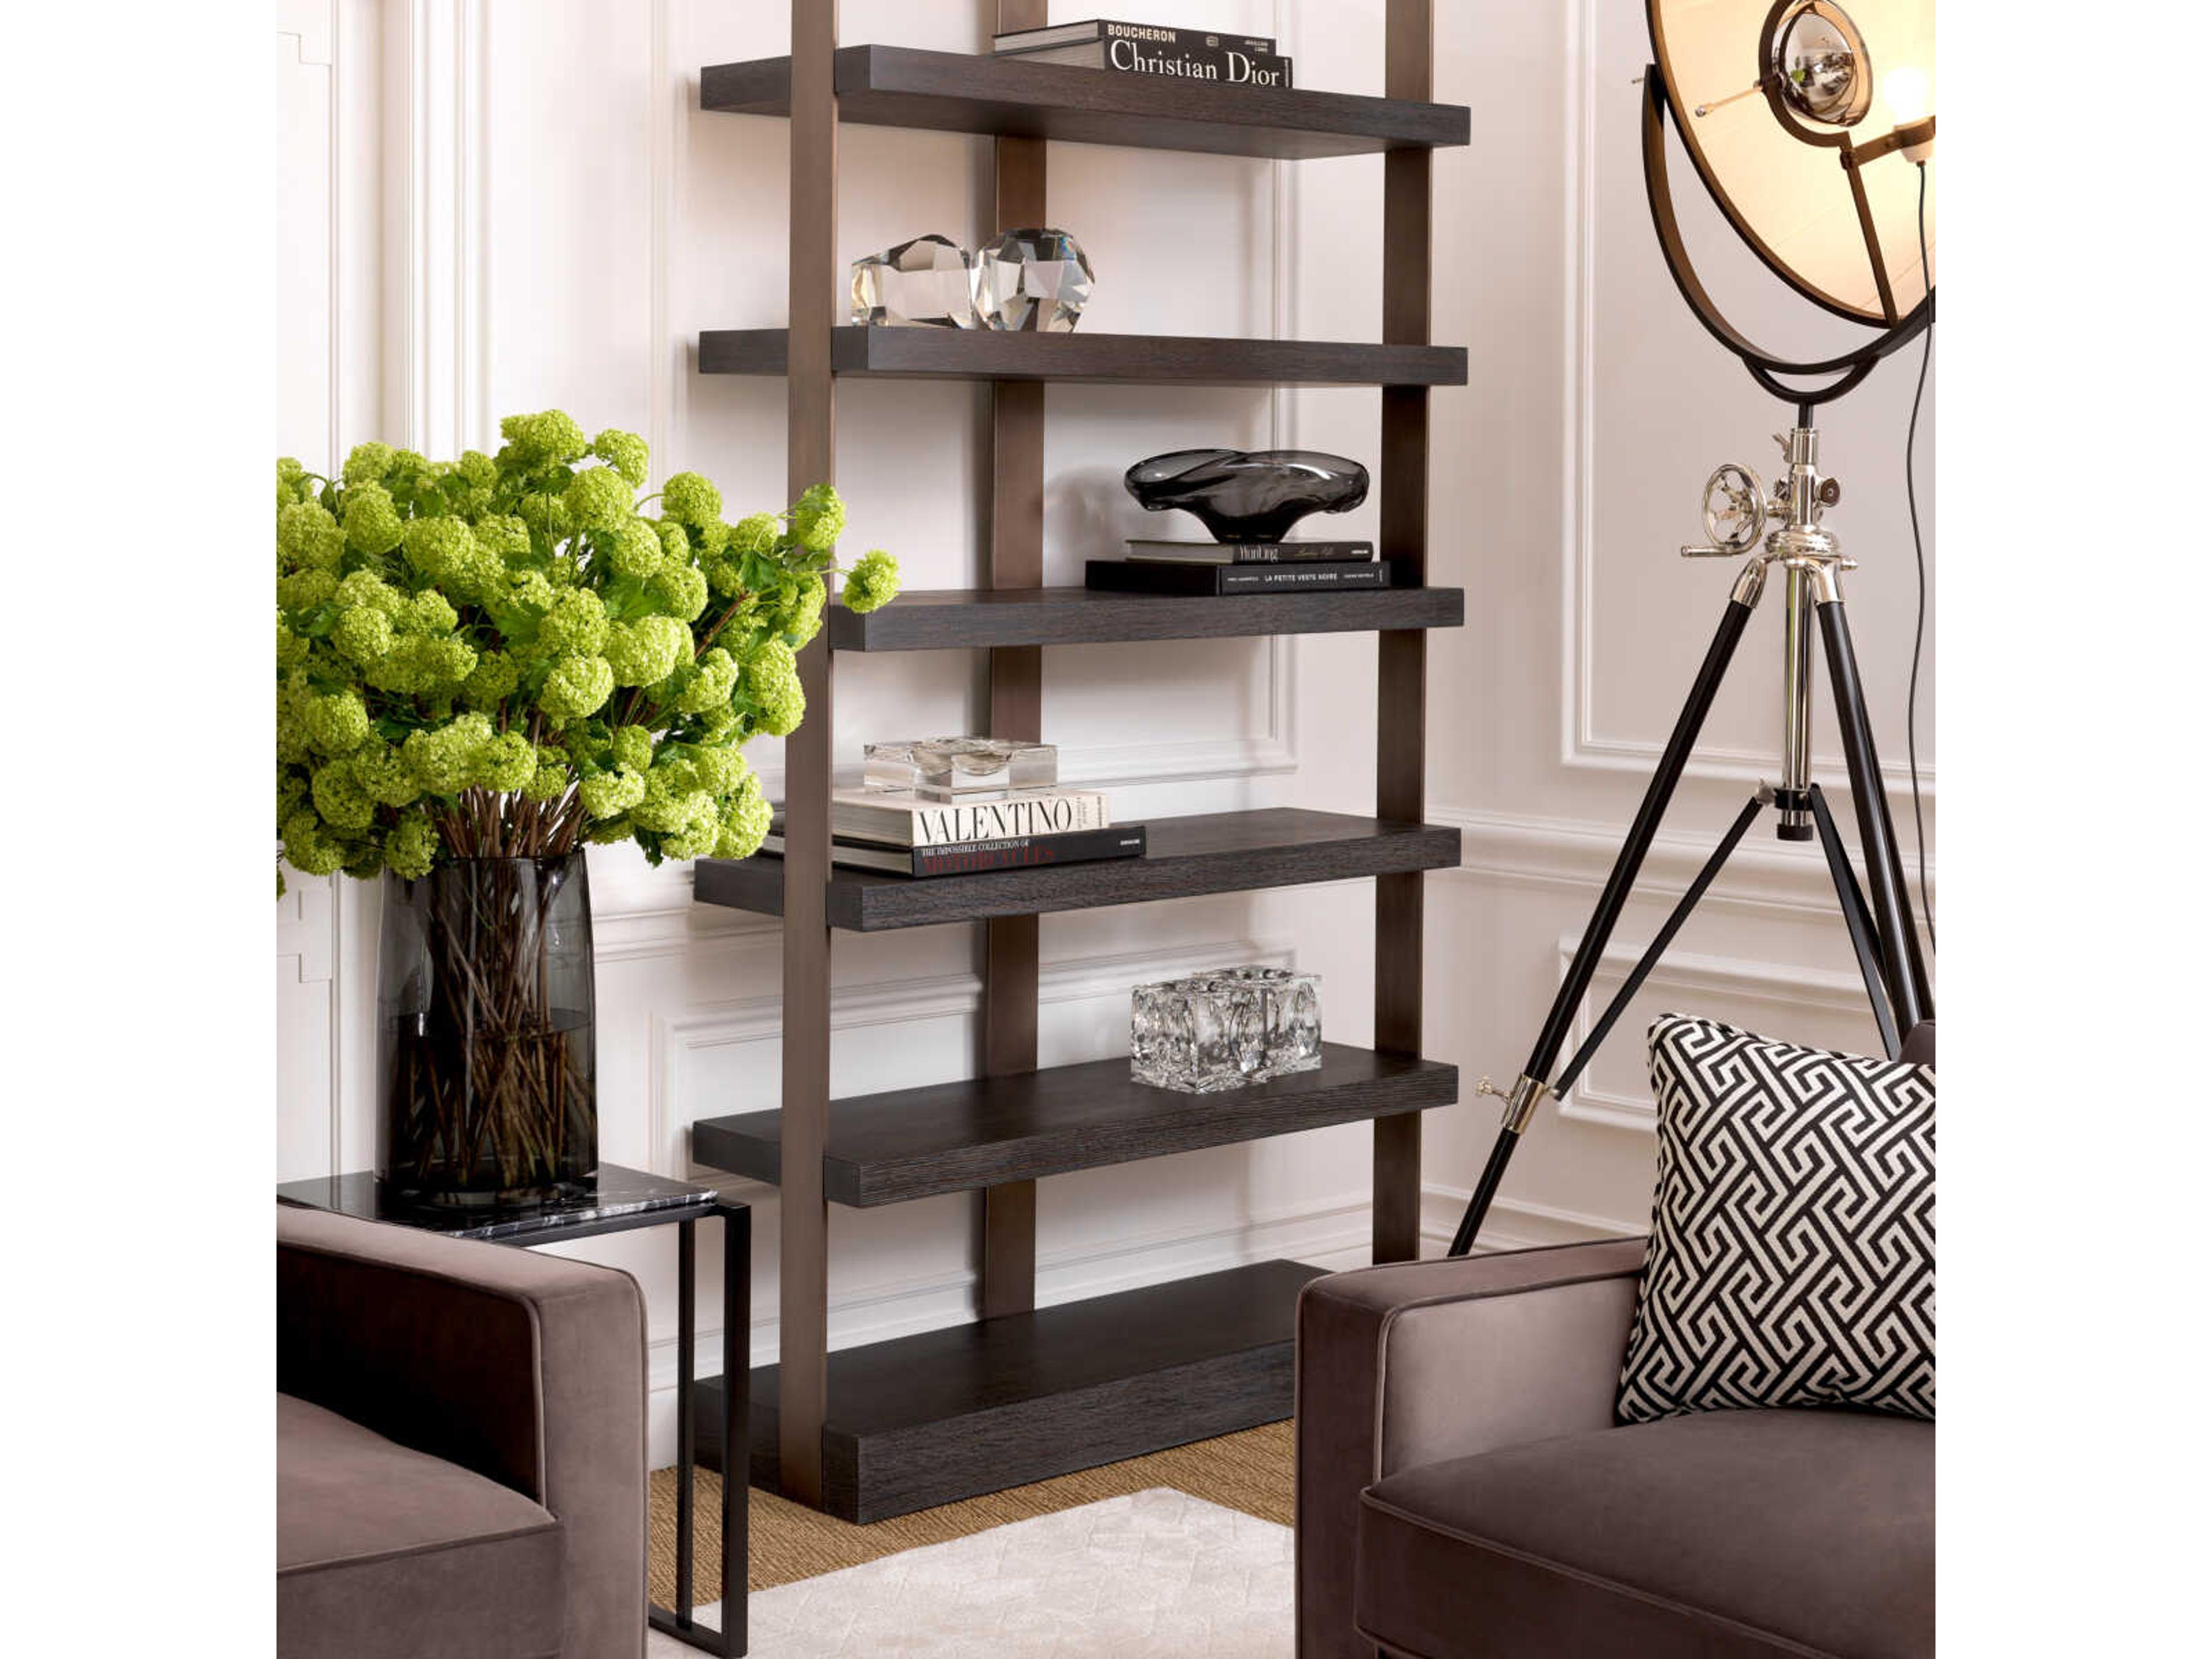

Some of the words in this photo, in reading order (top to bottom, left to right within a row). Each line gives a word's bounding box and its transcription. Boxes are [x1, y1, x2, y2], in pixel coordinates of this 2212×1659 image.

[1107, 24, 1176, 43] BOUCHERON
[1111, 40, 1218, 79] Christian
[1226, 51, 1279, 86] Dior
[918, 797, 1072, 843] VALENTINO
[979, 840, 1019, 853] COLLECTION
